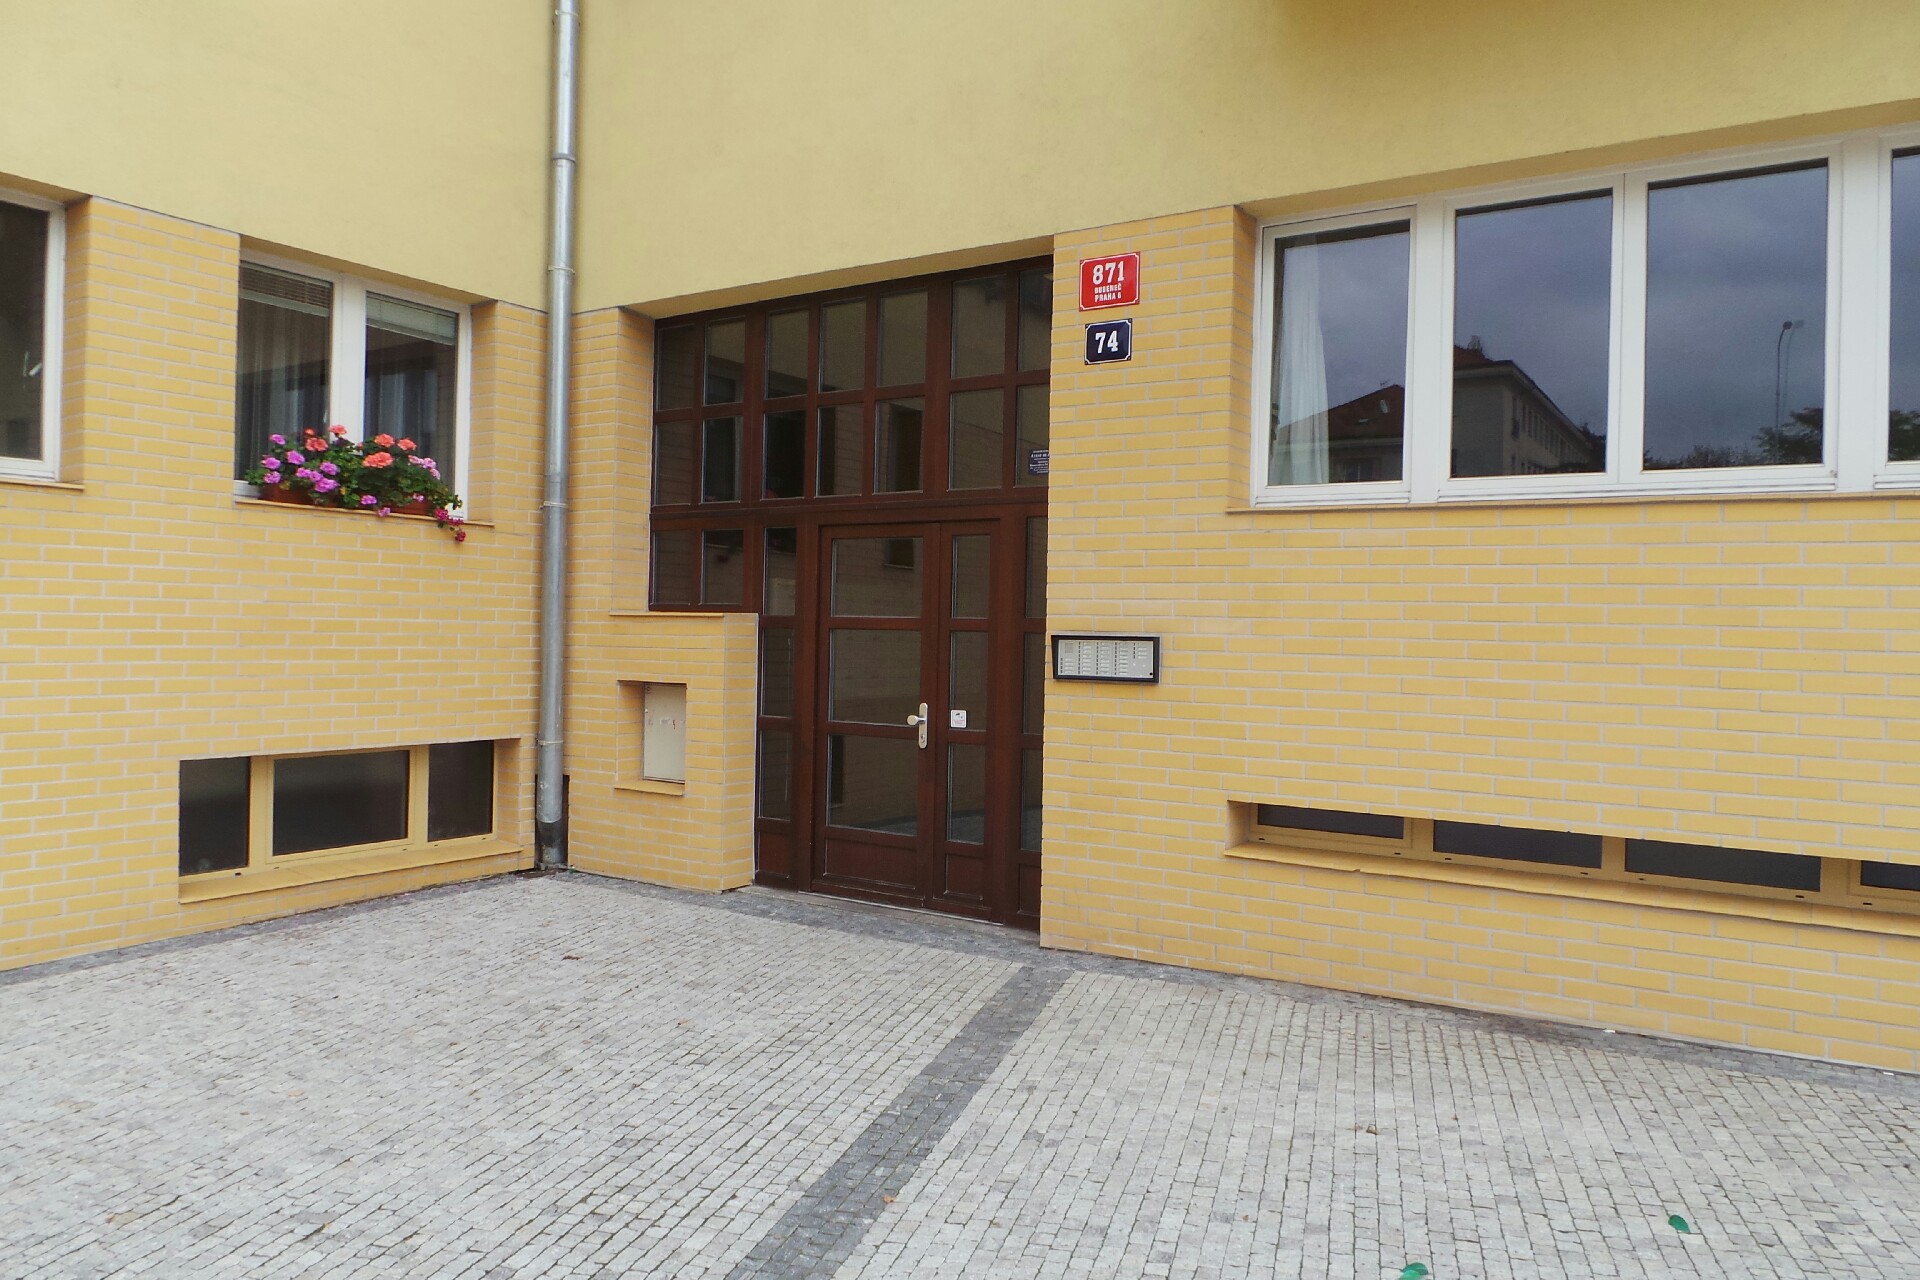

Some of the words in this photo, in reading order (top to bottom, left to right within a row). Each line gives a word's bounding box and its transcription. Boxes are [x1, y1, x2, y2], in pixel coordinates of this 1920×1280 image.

[1093, 261, 1124, 285] 871
[1094, 292, 1116, 303] PRAHA
[1095, 330, 1119, 354] 74
